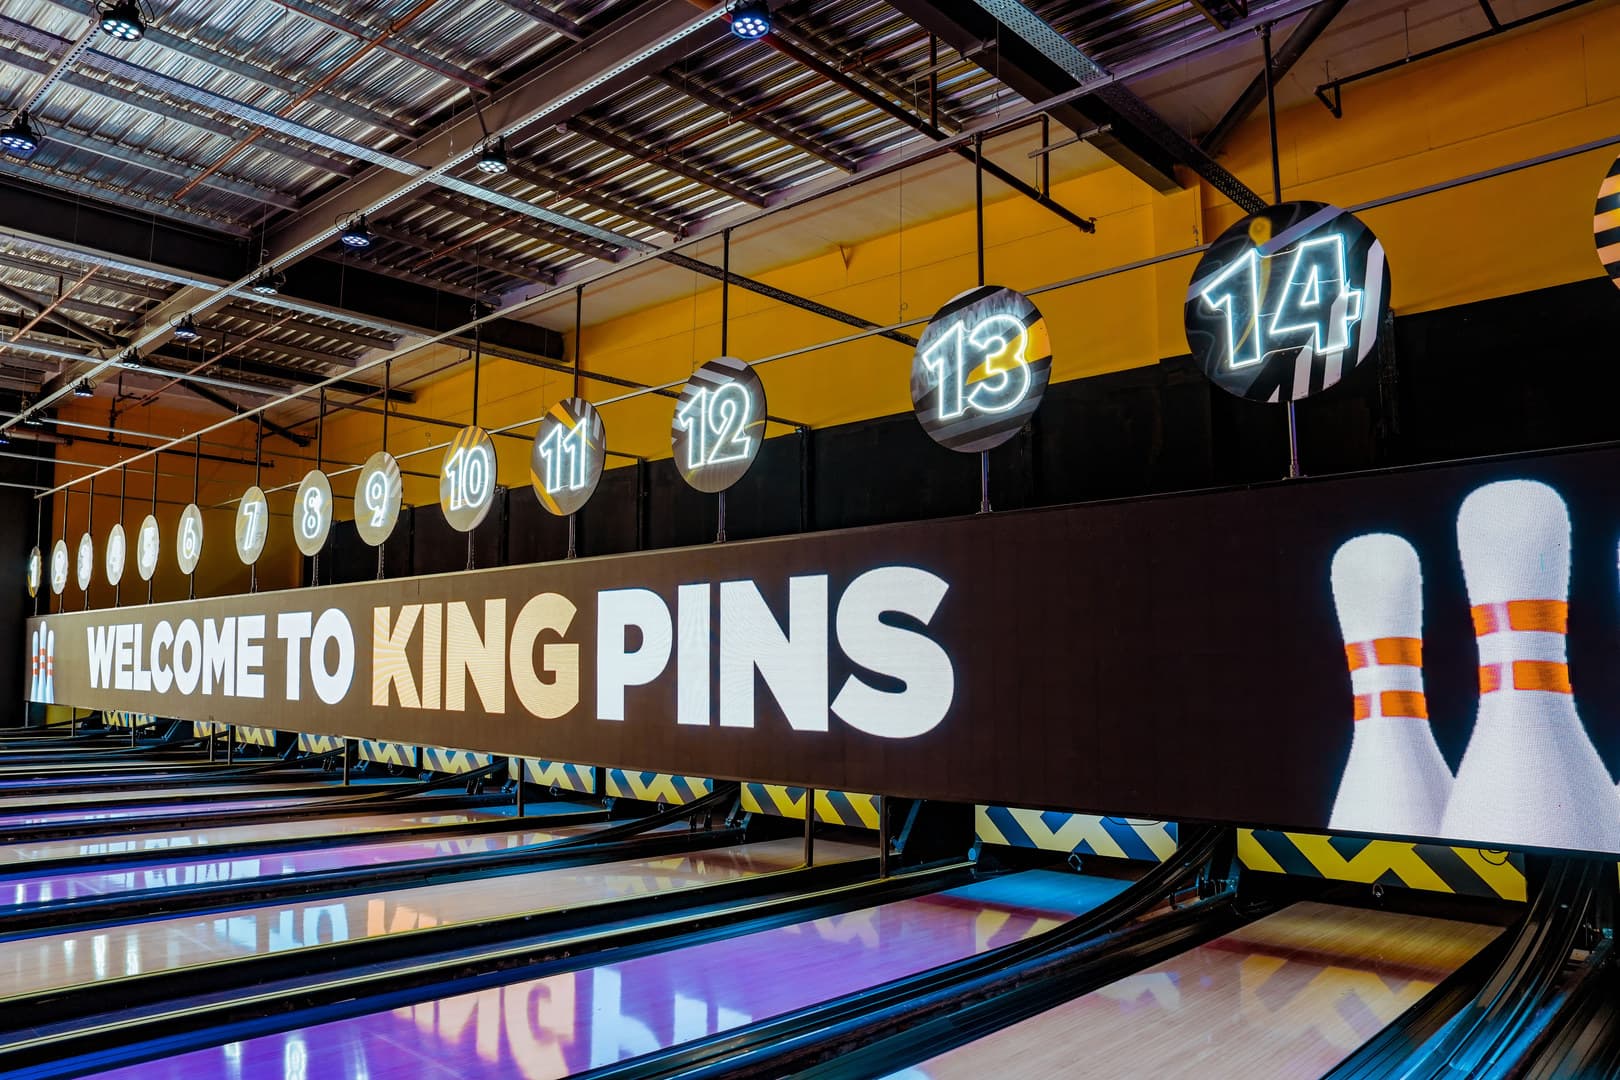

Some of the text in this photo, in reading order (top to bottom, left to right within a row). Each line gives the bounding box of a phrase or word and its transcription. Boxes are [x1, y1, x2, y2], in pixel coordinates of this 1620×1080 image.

[1202, 233, 1364, 370] 14
[922, 313, 1032, 421] 13
[538, 417, 588, 494] 11
[679, 381, 751, 470] 12
[302, 487, 321, 539] 8
[366, 471, 388, 527] 9
[444, 446, 490, 511] 10
[183, 517, 196, 560] 6
[244, 501, 260, 550] 7
[86, 566, 955, 739] WELCOME TO KING PINS
